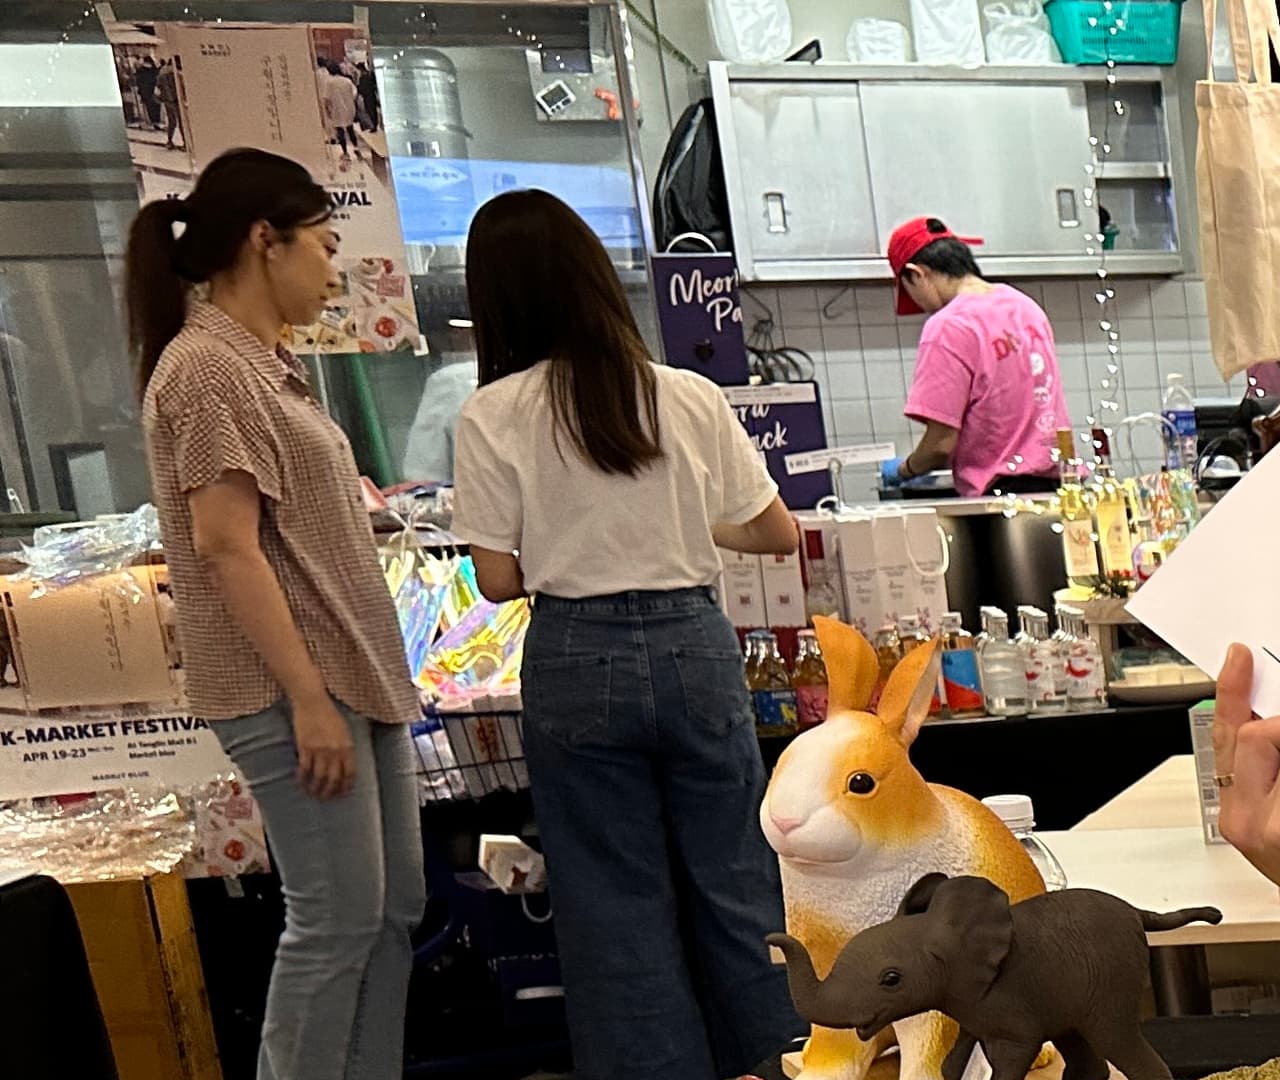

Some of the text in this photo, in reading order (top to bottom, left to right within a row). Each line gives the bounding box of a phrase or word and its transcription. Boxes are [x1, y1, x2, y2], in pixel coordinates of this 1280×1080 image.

[706, 297, 743, 331] Pa
[1, 716, 209, 746] K-MARKET FESTIVA
[23, 749, 86, 763] APR 19-23
